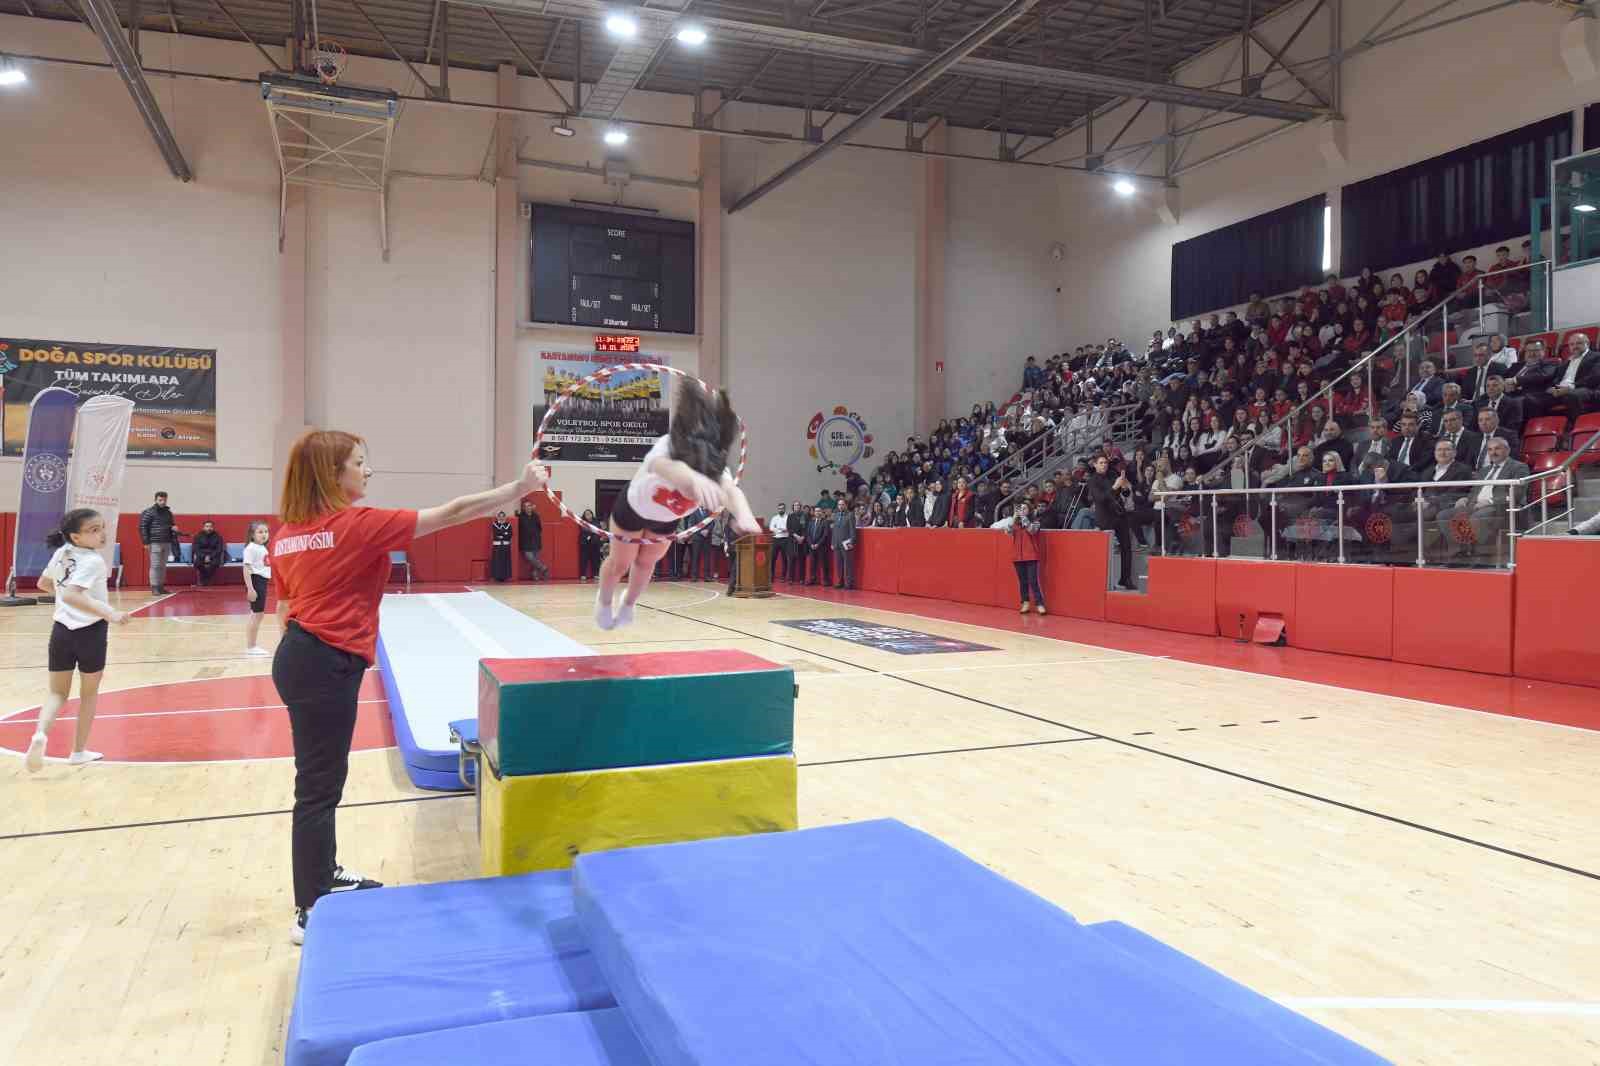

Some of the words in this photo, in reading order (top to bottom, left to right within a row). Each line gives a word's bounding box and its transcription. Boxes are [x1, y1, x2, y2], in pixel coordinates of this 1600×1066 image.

[607, 228, 626, 238] SCORE
[19, 347, 80, 365] DOĞA
[82, 352, 134, 367] SPOR
[137, 353, 212, 370] KULÜBÜ
[54, 369, 89, 382] TÜM
[91, 372, 180, 385] TAKIMLARA
